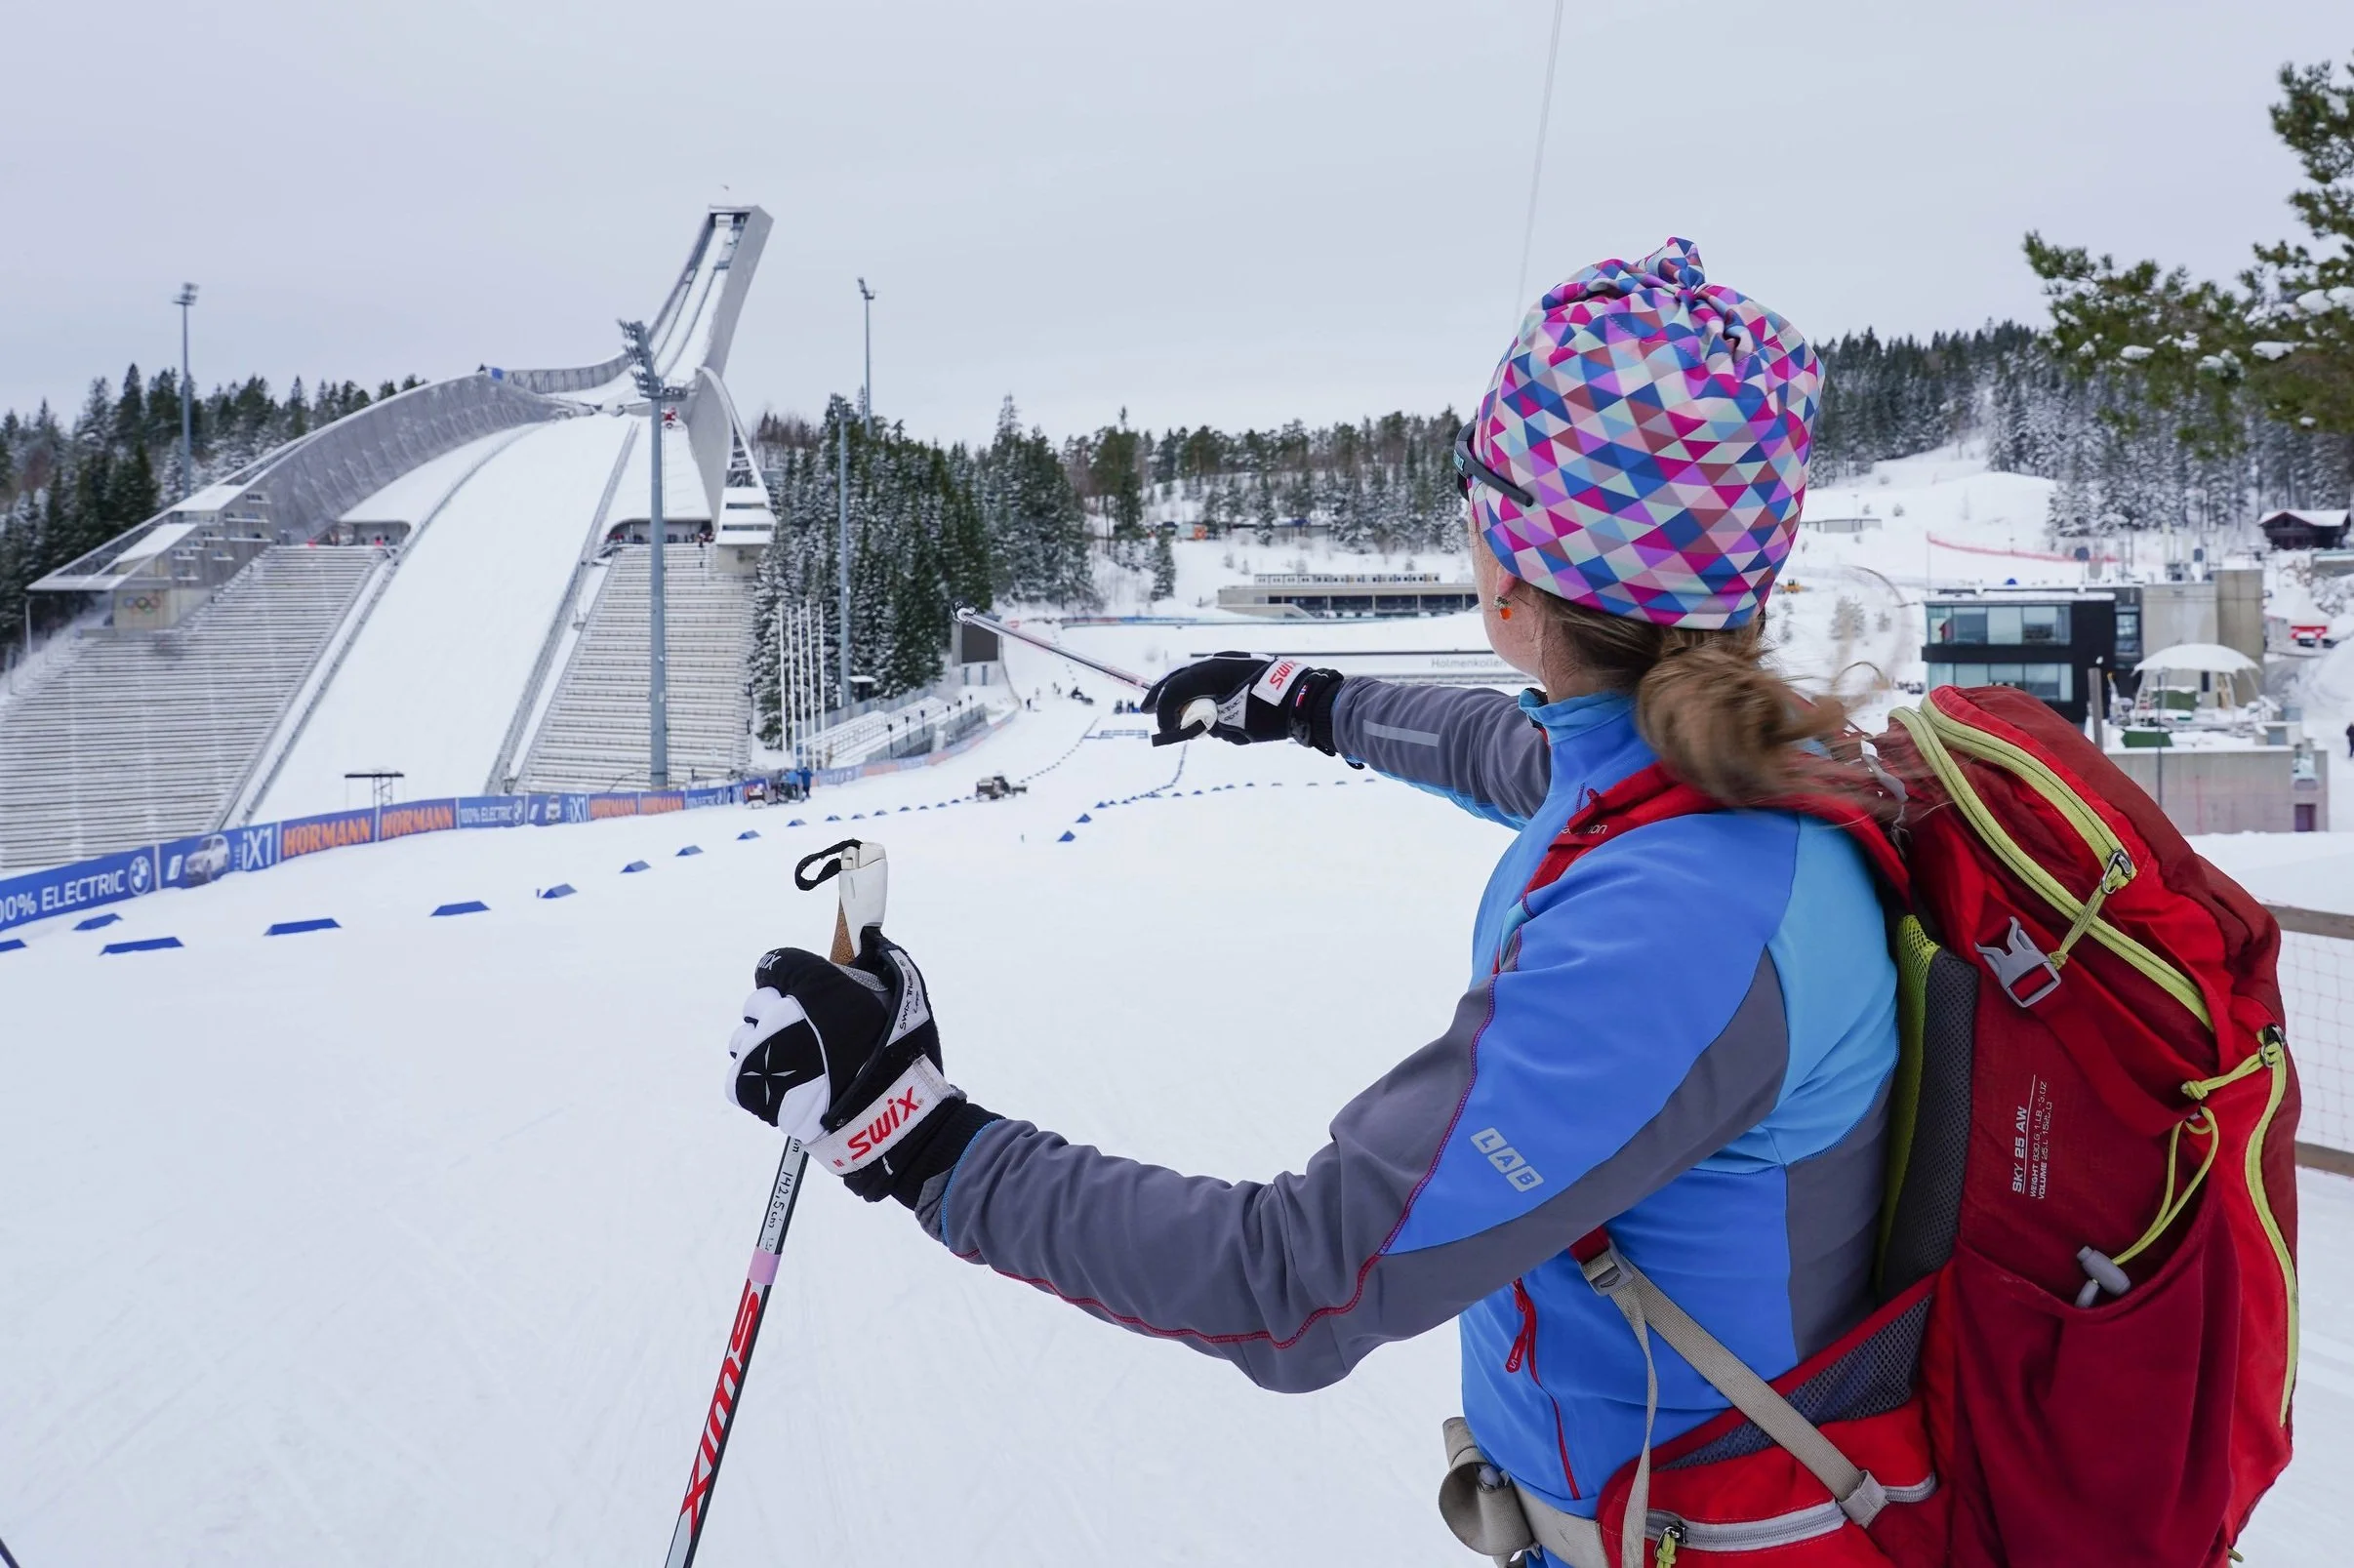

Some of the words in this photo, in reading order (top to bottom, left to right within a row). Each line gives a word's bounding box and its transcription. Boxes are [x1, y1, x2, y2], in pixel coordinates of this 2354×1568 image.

[243, 827, 272, 869] iX1
[42, 869, 125, 911] ELECTRIC
[2015, 1106, 2027, 1134] AW
[1475, 1131, 1541, 1188] LAB
[2014, 1137, 2025, 1159] 25
[2012, 1162, 2023, 1192] SKY
[2038, 1161, 2048, 1199] VOLUME
